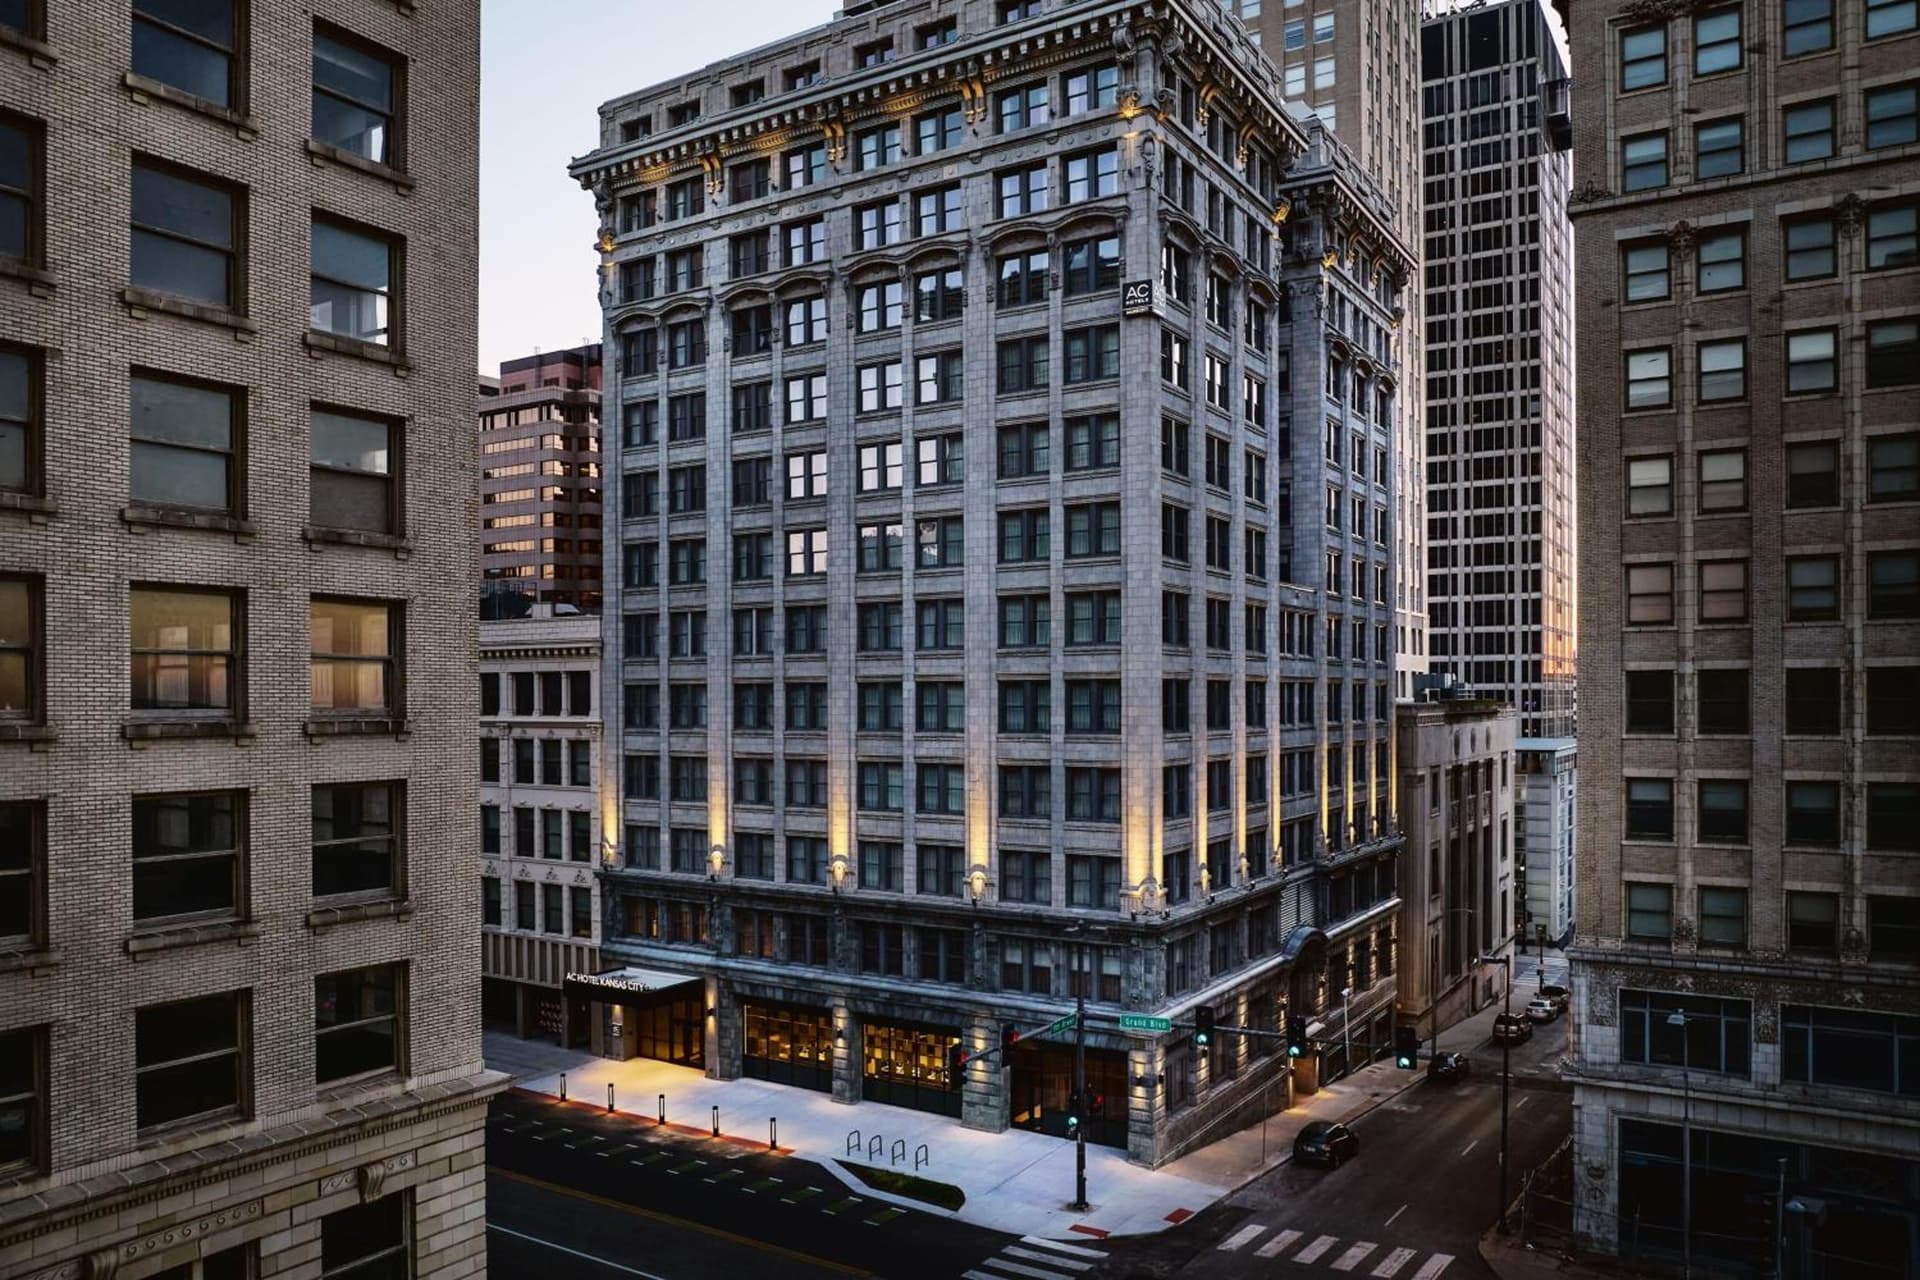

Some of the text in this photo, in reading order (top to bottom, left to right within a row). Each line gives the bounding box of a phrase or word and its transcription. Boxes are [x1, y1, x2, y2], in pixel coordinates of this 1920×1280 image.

[1126, 284, 1149, 300] AC
[566, 972, 644, 992] AC HOTEL KANSAS CITY
[1125, 1018, 1146, 1028] Grand
